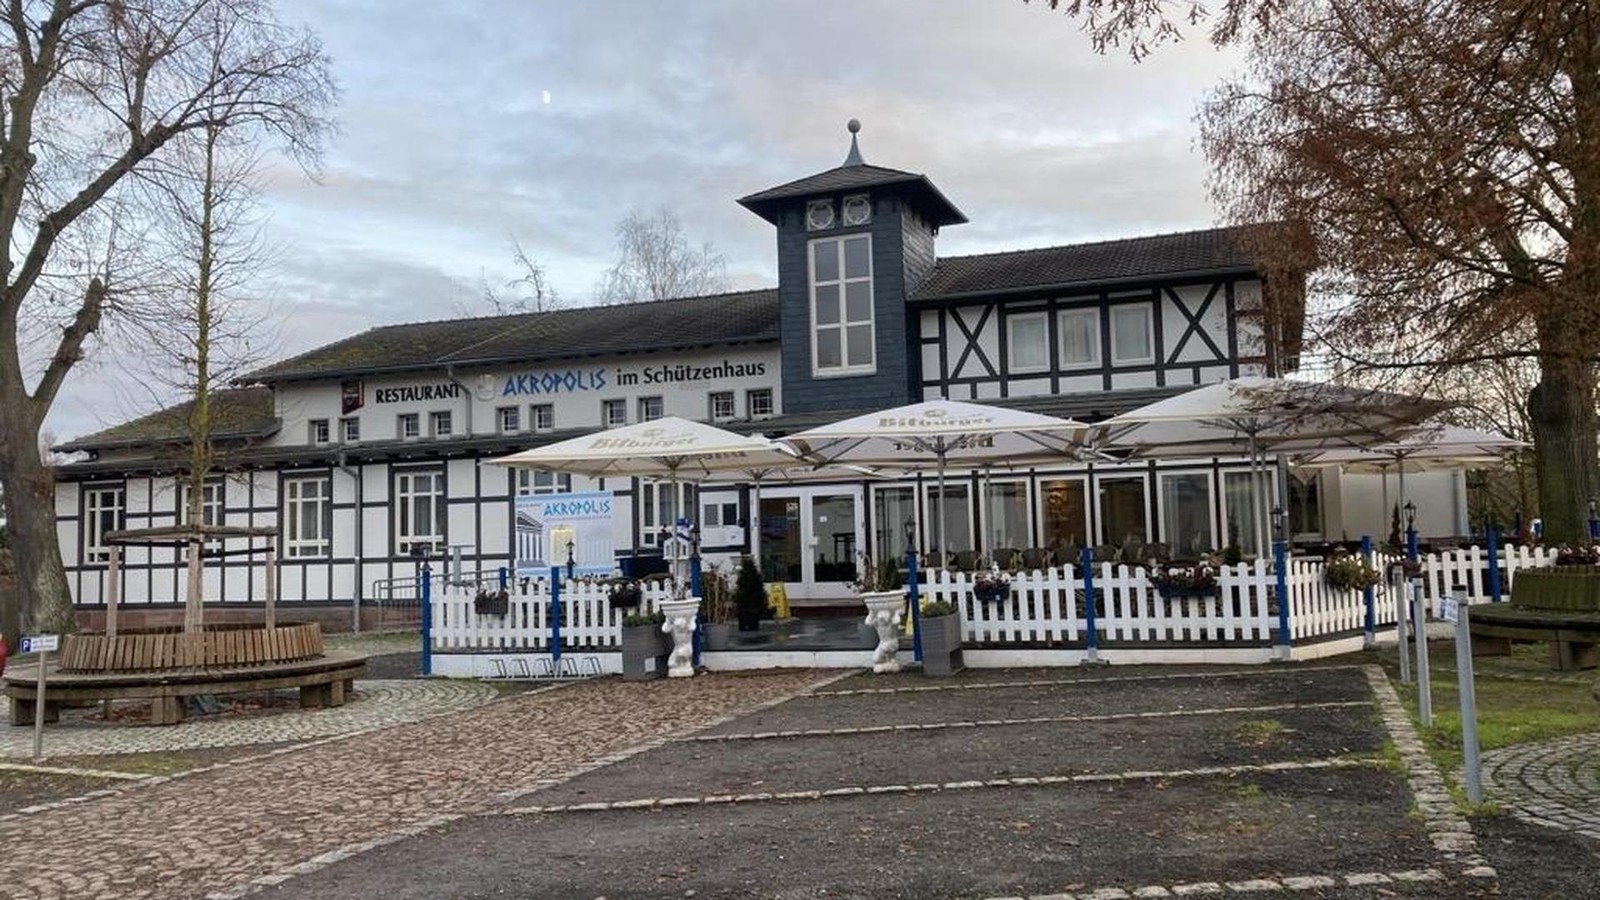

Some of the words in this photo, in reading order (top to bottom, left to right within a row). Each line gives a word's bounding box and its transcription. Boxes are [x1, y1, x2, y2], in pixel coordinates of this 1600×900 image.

[502, 369, 606, 396] AKROPOLIS
[617, 369, 638, 386] im
[643, 360, 766, 384] Schützenhaus
[375, 383, 460, 404] RESTAURANT
[543, 501, 610, 516] AKROPOLIS
